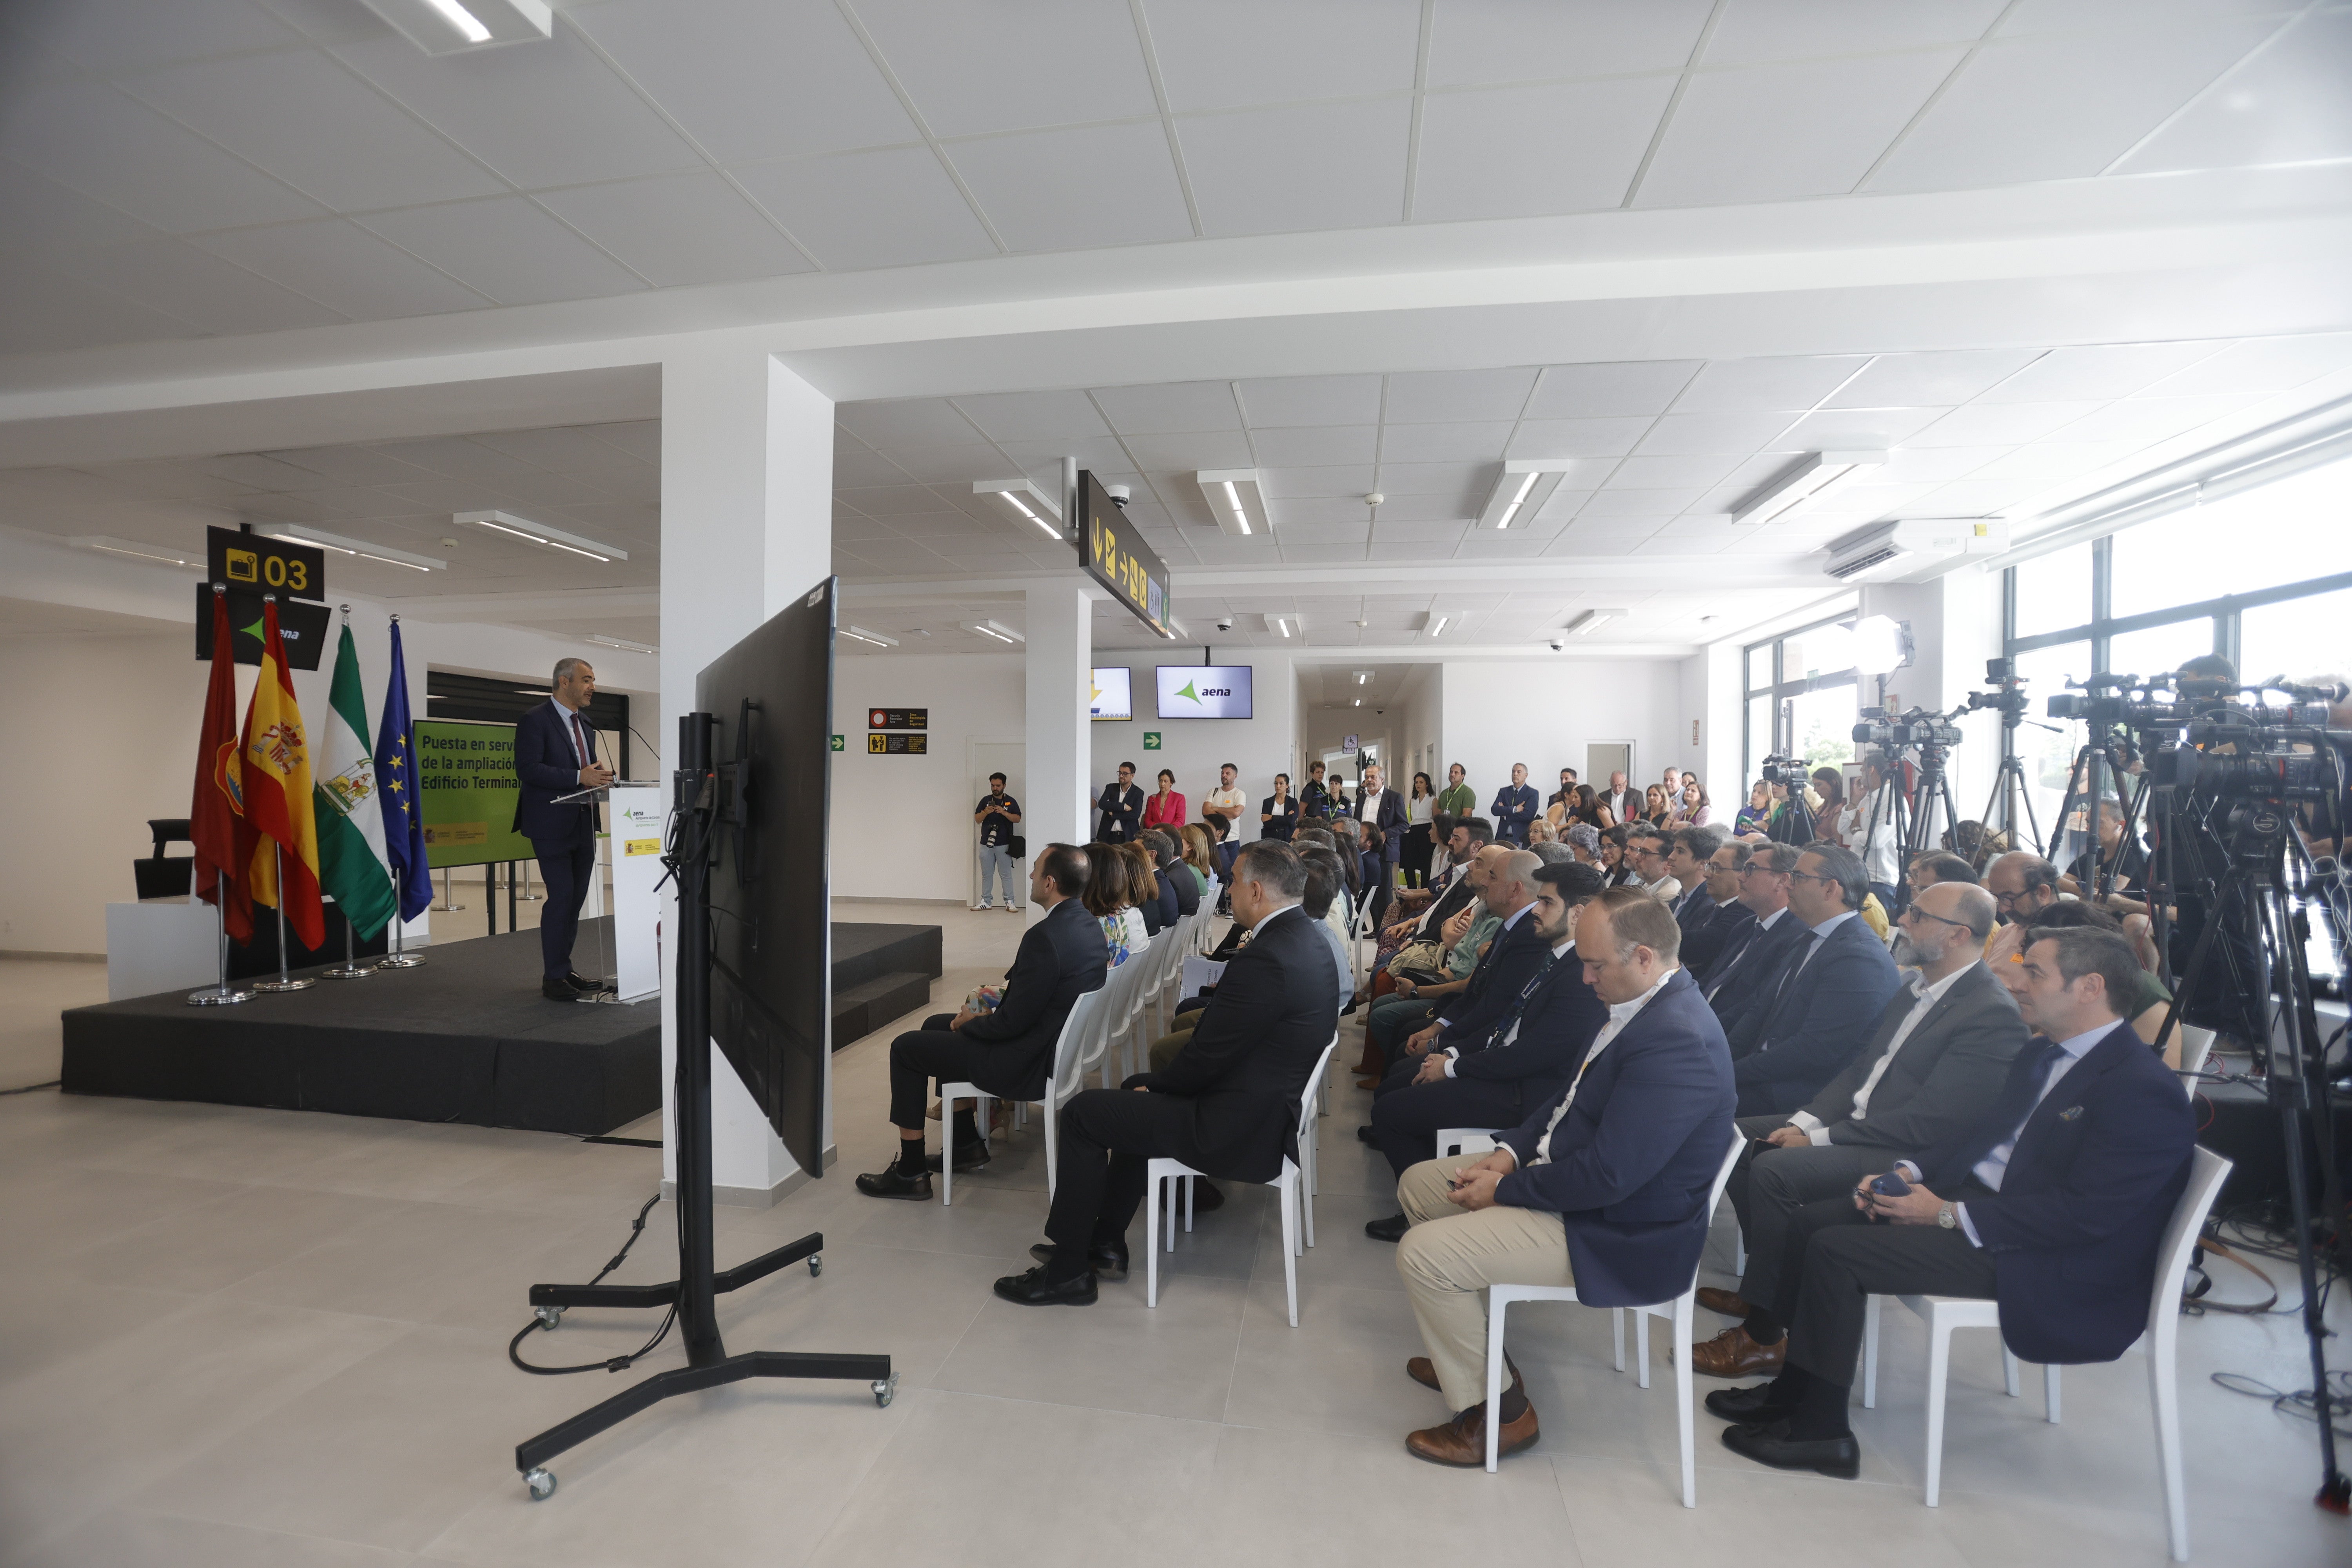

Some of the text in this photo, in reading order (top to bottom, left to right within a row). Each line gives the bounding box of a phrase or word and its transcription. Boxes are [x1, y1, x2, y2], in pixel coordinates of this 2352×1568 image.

[265, 555, 307, 590] 03
[1141, 575, 1145, 602] C
[279, 629, 300, 640] ena
[423, 735, 467, 750] Puesta
[470, 740, 485, 750] en
[422, 755, 437, 769] de
[442, 755, 453, 769] la
[421, 775, 468, 789] Edificio
